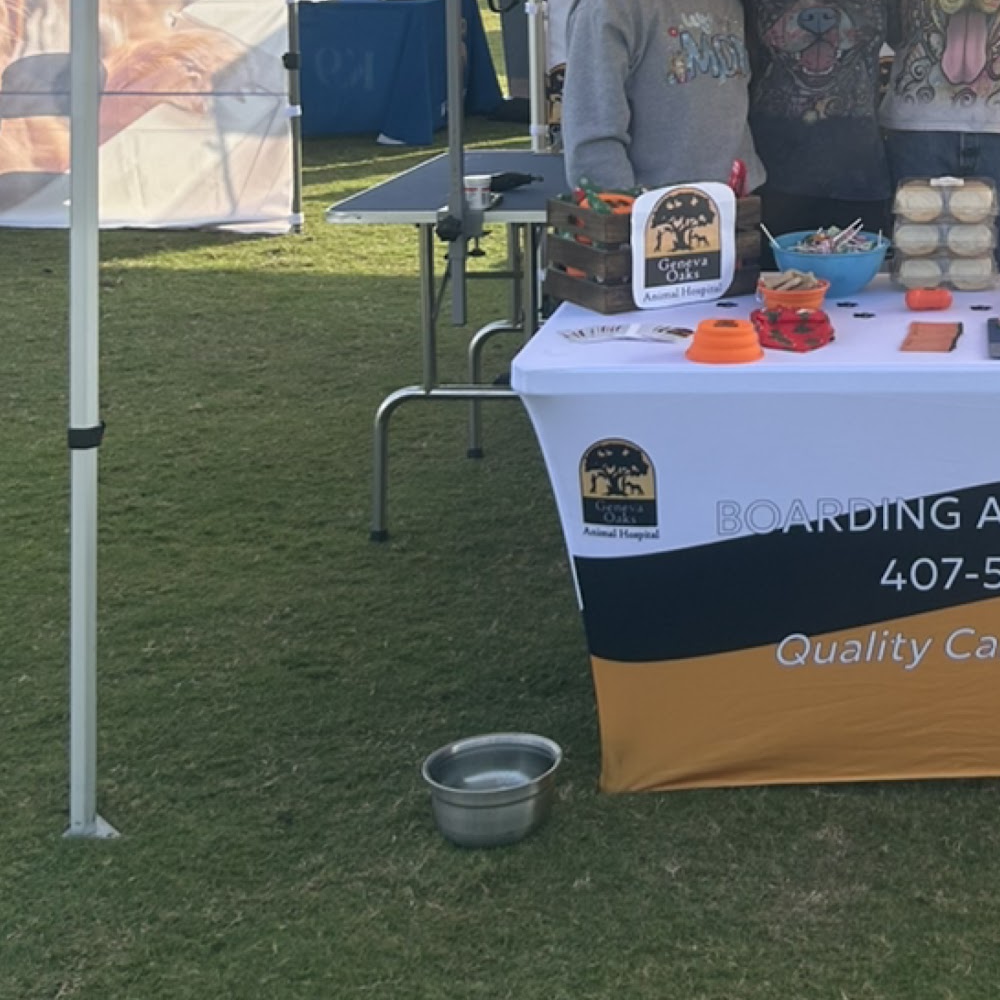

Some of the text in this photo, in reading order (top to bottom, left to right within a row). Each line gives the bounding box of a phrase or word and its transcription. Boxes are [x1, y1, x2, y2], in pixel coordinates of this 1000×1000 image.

[657, 256, 708, 272] Geneva
[666, 270, 700, 283] Oaks
[643, 283, 723, 303] Animal Hospital
[595, 500, 645, 514] Geneva
[602, 512, 638, 525] Oaks
[715, 496, 960, 536] BOARDING
[582, 526, 660, 542] Animal Hospital
[775, 629, 932, 670] Quality
